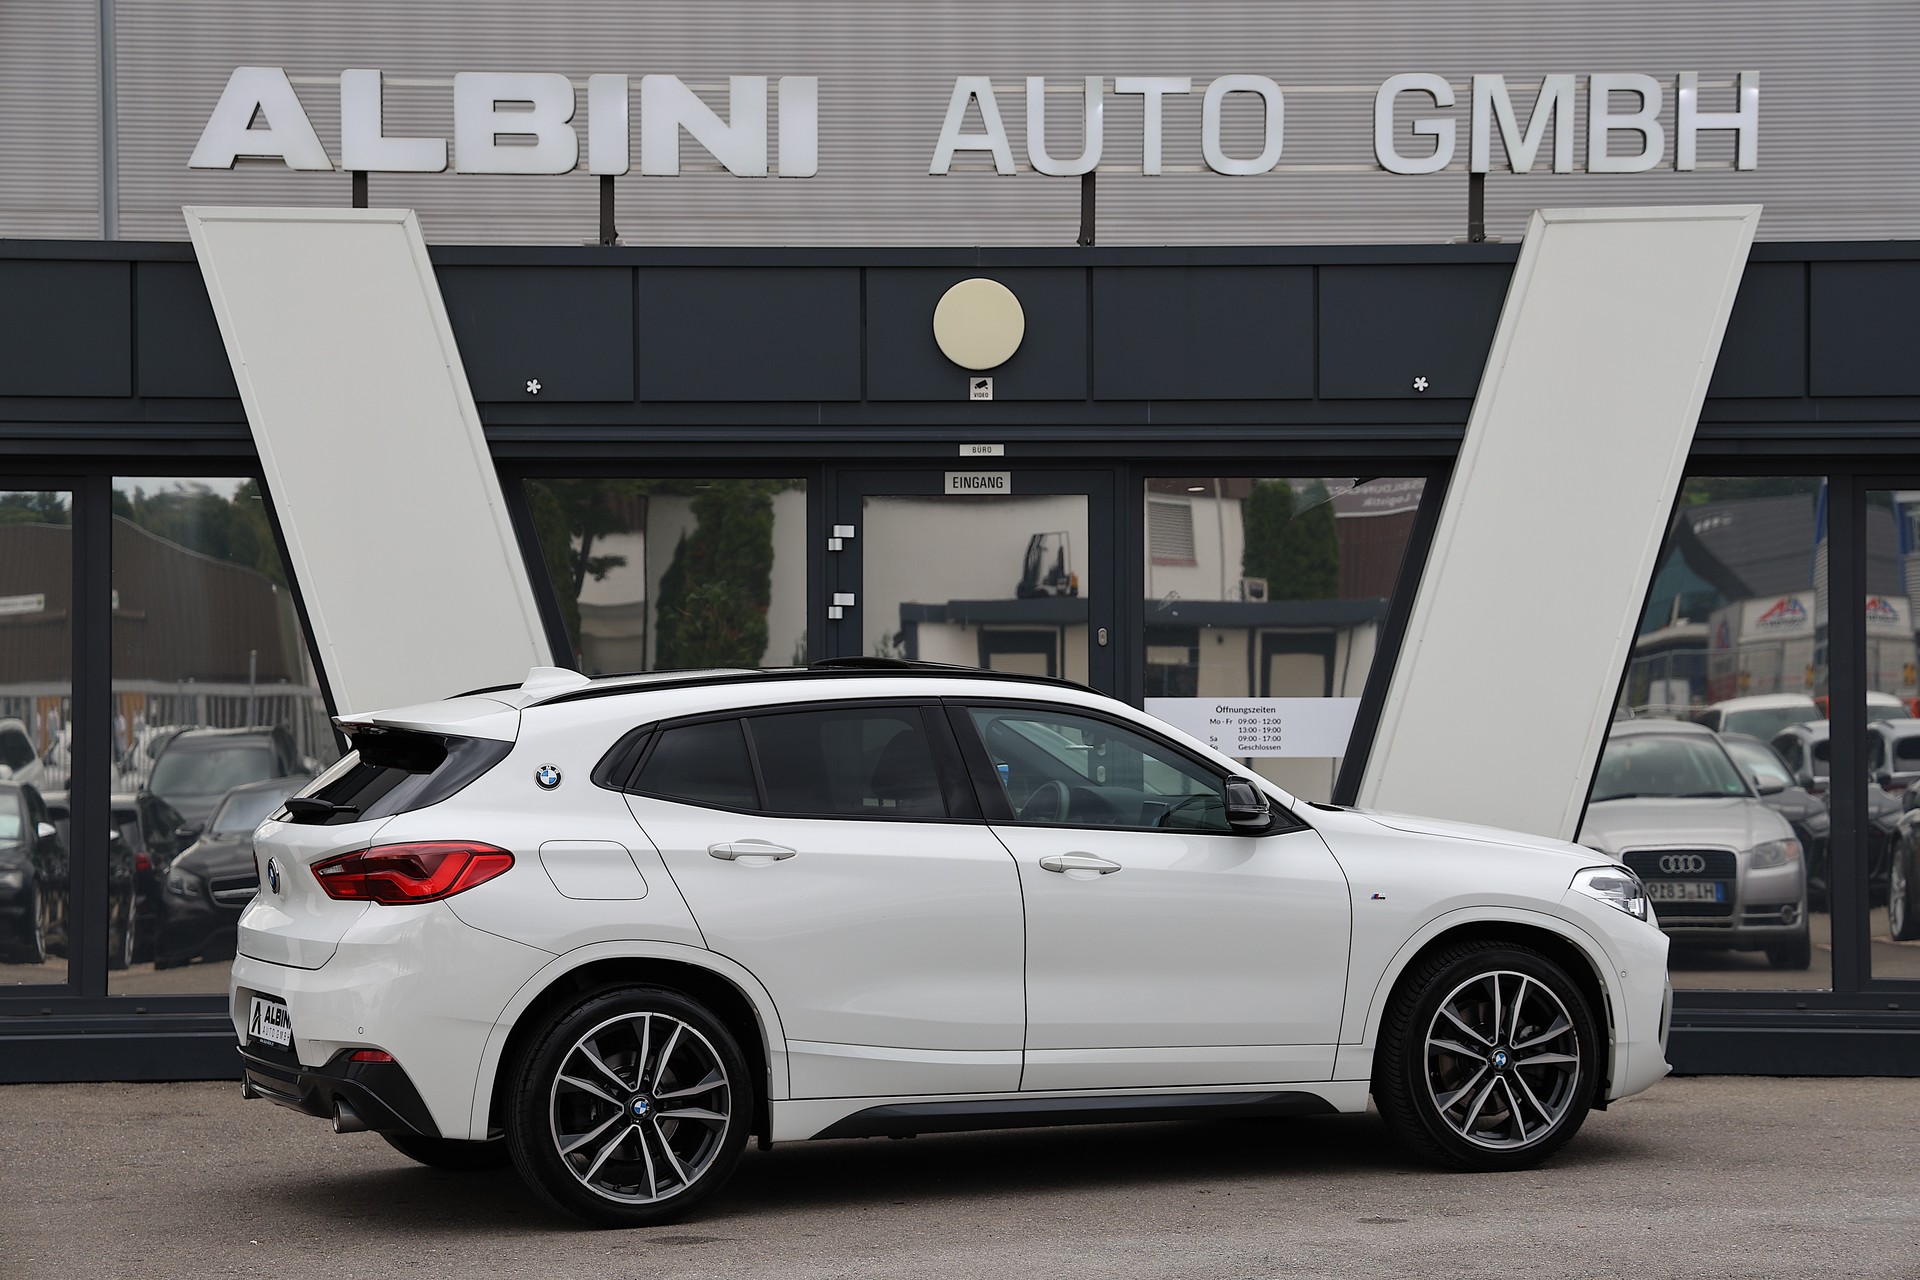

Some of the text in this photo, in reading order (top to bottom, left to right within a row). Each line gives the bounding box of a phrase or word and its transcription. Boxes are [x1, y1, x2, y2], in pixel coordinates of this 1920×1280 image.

[187, 66, 1761, 178] ALBINI AUTO GMBH
[952, 476, 1004, 489] EINGANG
[1215, 705, 1276, 715] Öffnungszeiten
